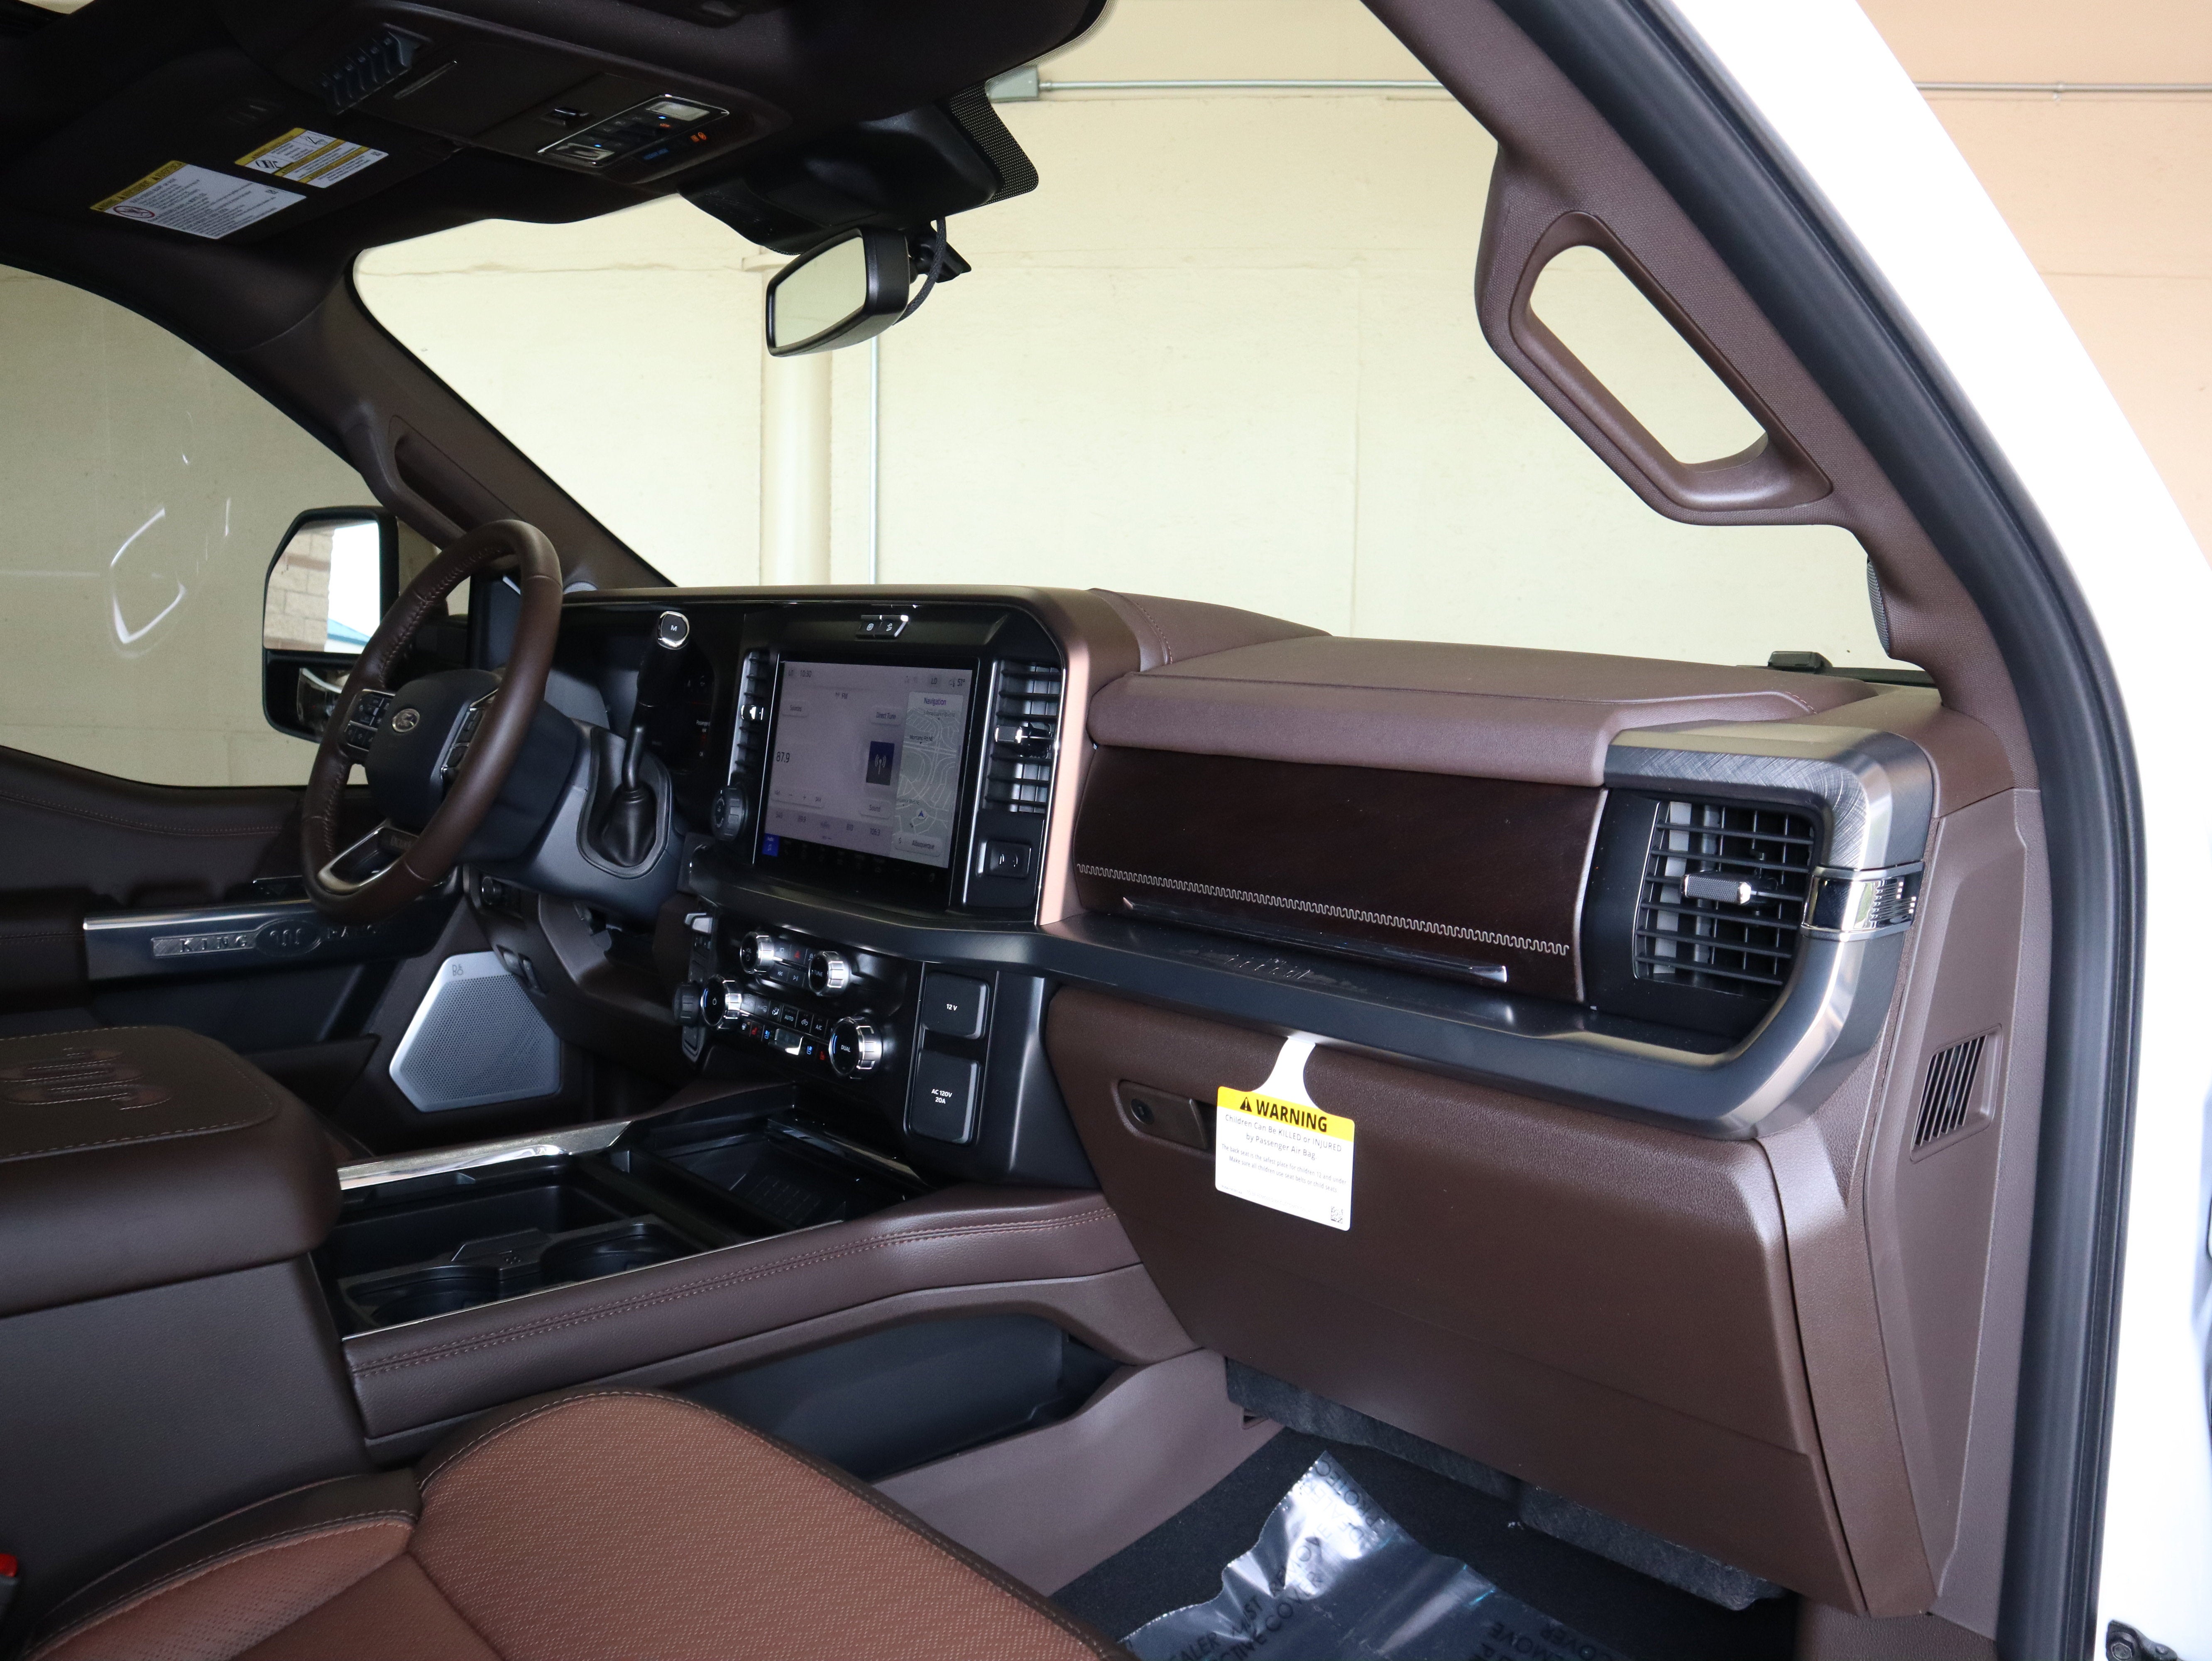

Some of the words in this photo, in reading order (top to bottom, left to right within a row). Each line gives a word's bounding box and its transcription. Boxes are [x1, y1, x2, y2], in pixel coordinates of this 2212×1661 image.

[800, 670, 812, 678] 10:30
[923, 697, 947, 706] Navigation
[776, 751, 790, 763] 87.9
[869, 804, 881, 812] Sound
[912, 840, 935, 849] Albuquerque
[179, 935, 247, 953] KING
[840, 1044, 851, 1053] DUAL
[1256, 1099, 1327, 1133] WARNING
[1225, 1114, 1252, 1128] Children
[1254, 1122, 1266, 1131] Can
[1268, 1126, 1276, 1134] Be
[1279, 1129, 1301, 1141] KILLED
[1313, 1138, 1342, 1152] INJURED
[1246, 1132, 1254, 1143] by
[1255, 1136, 1289, 1151] Passenger
[1291, 1146, 1301, 1154] Air
[1303, 1149, 1317, 1161] Bag.
[1230, 1146, 1239, 1154] back
[1263, 1156, 1276, 1165] safest
[1297, 1166, 1315, 1176] children
[1333, 1177, 1347, 1185] under
[1229, 1156, 1241, 1165] Make
[1258, 1165, 1275, 1174] children
[1295, 1176, 1307, 1184] belts
[1325, 1185, 1337, 1193] seats
